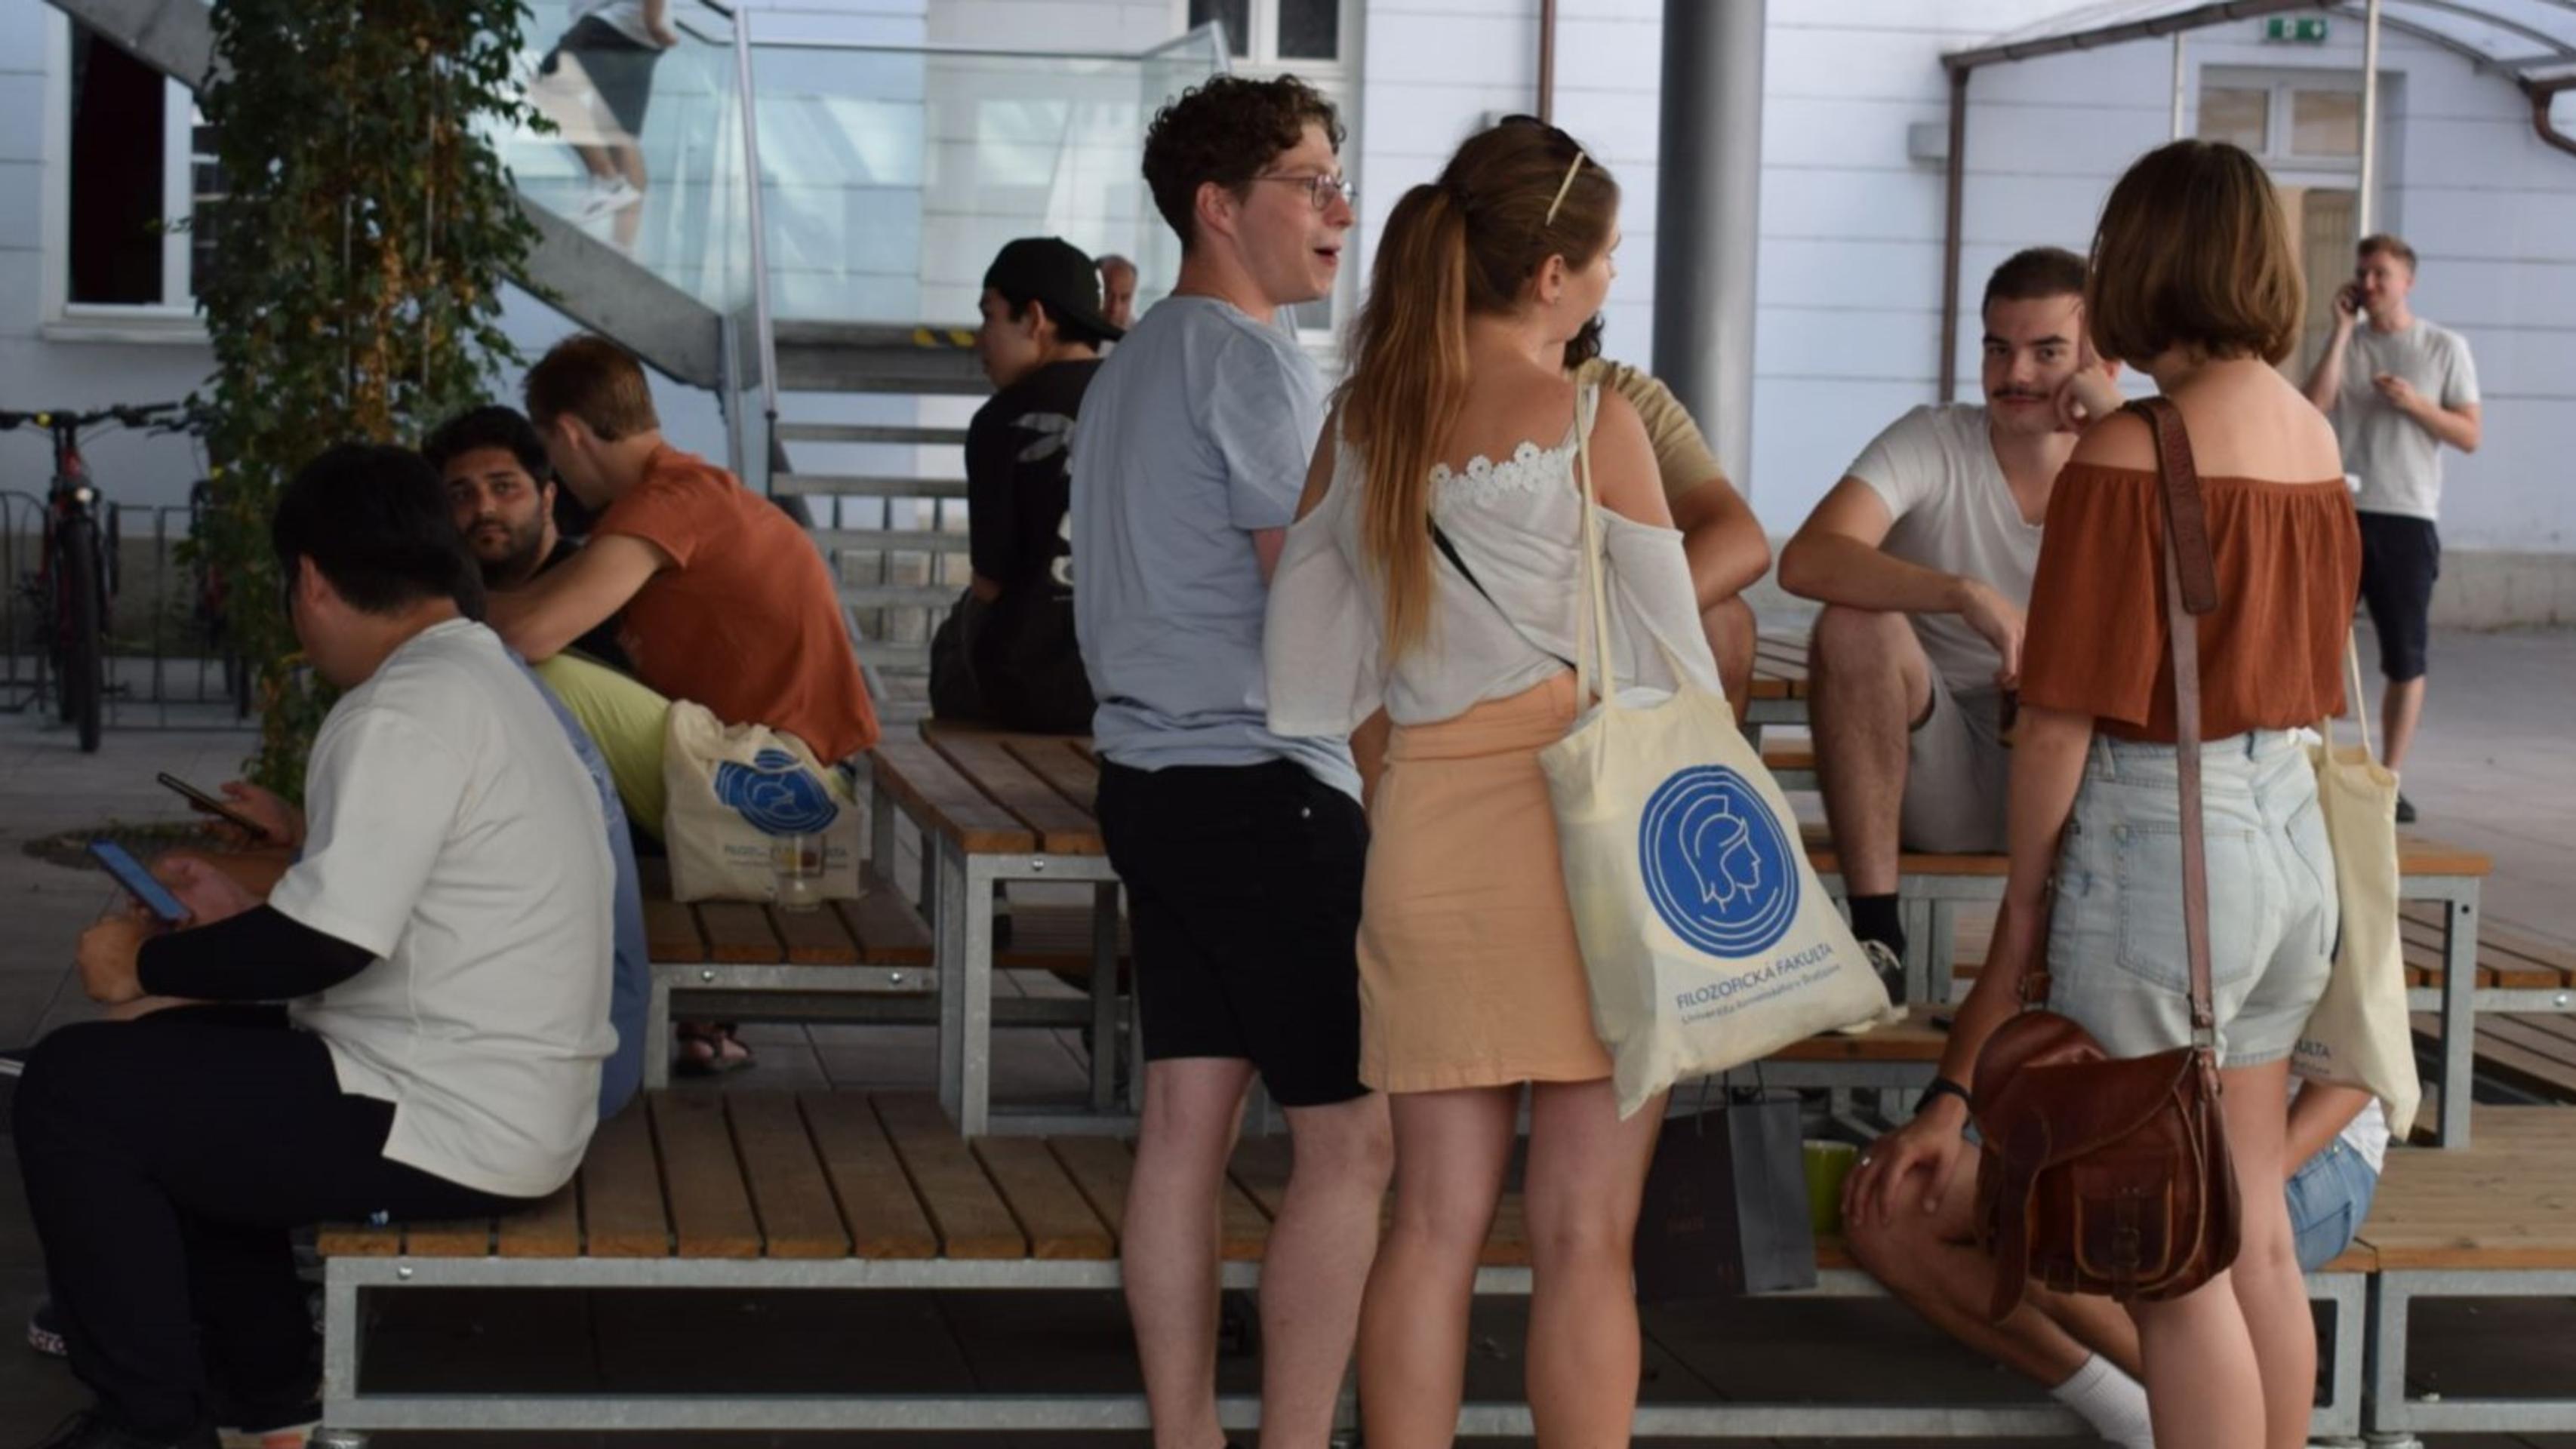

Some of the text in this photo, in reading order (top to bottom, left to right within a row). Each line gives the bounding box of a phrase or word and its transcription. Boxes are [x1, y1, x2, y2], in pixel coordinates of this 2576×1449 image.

[1676, 943, 1833, 1009] FILOZOFICKÁ FAKULTA
[2294, 1038, 2331, 1060] ULTA
